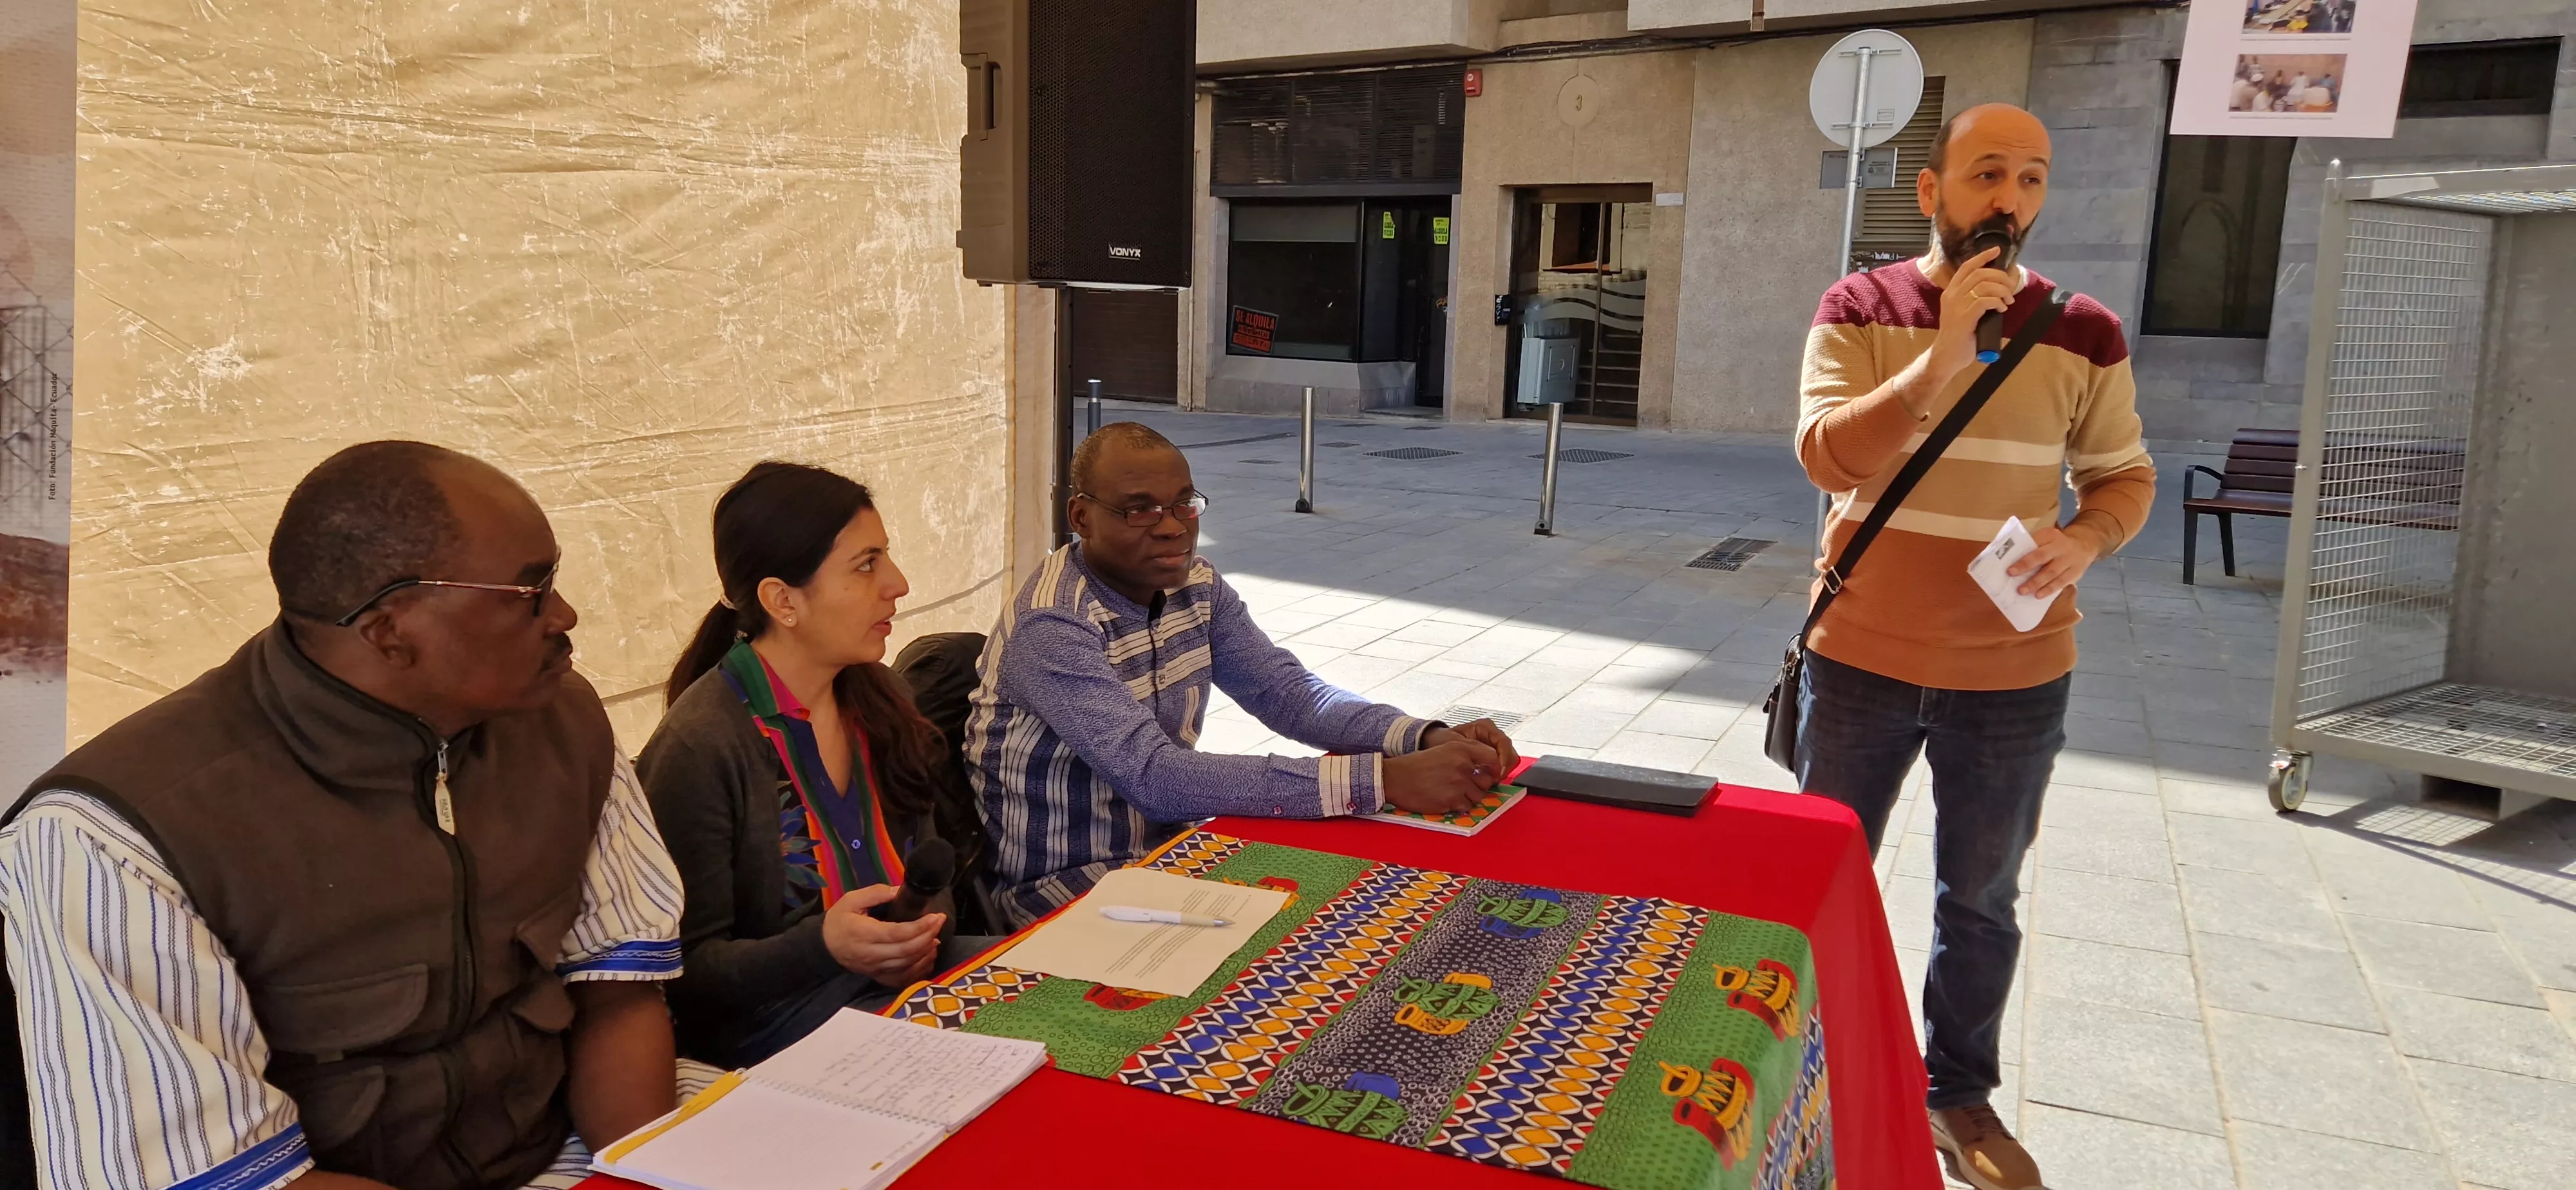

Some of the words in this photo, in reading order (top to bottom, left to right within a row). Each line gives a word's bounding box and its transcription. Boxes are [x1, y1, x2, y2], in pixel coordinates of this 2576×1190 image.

[1110, 247, 1141, 258] VONYX
[1235, 309, 1244, 322] SE
[1245, 312, 1274, 330] ALQUILA
[48, 440, 57, 478] Fundación
